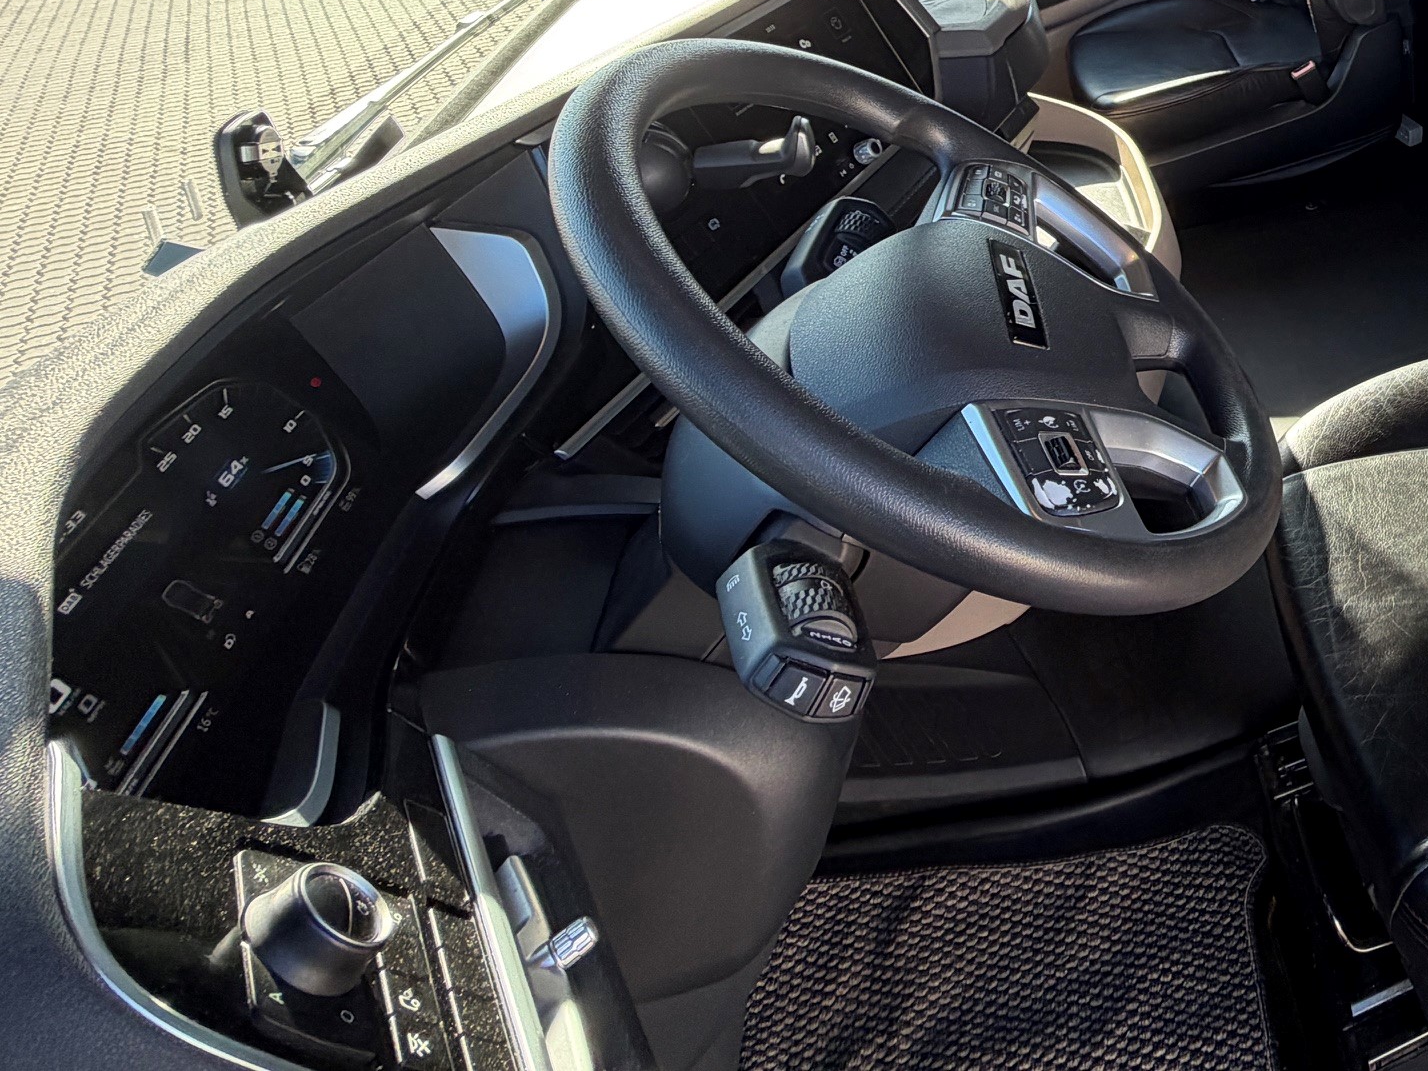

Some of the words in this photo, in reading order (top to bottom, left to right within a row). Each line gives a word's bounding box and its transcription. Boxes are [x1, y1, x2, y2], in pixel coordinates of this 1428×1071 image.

[1000, 254, 1036, 328] DAF
[218, 404, 234, 420] 15
[181, 423, 202, 444] 20
[283, 419, 297, 433] 10
[157, 451, 178, 473] 25
[300, 474, 312, 486] 0
